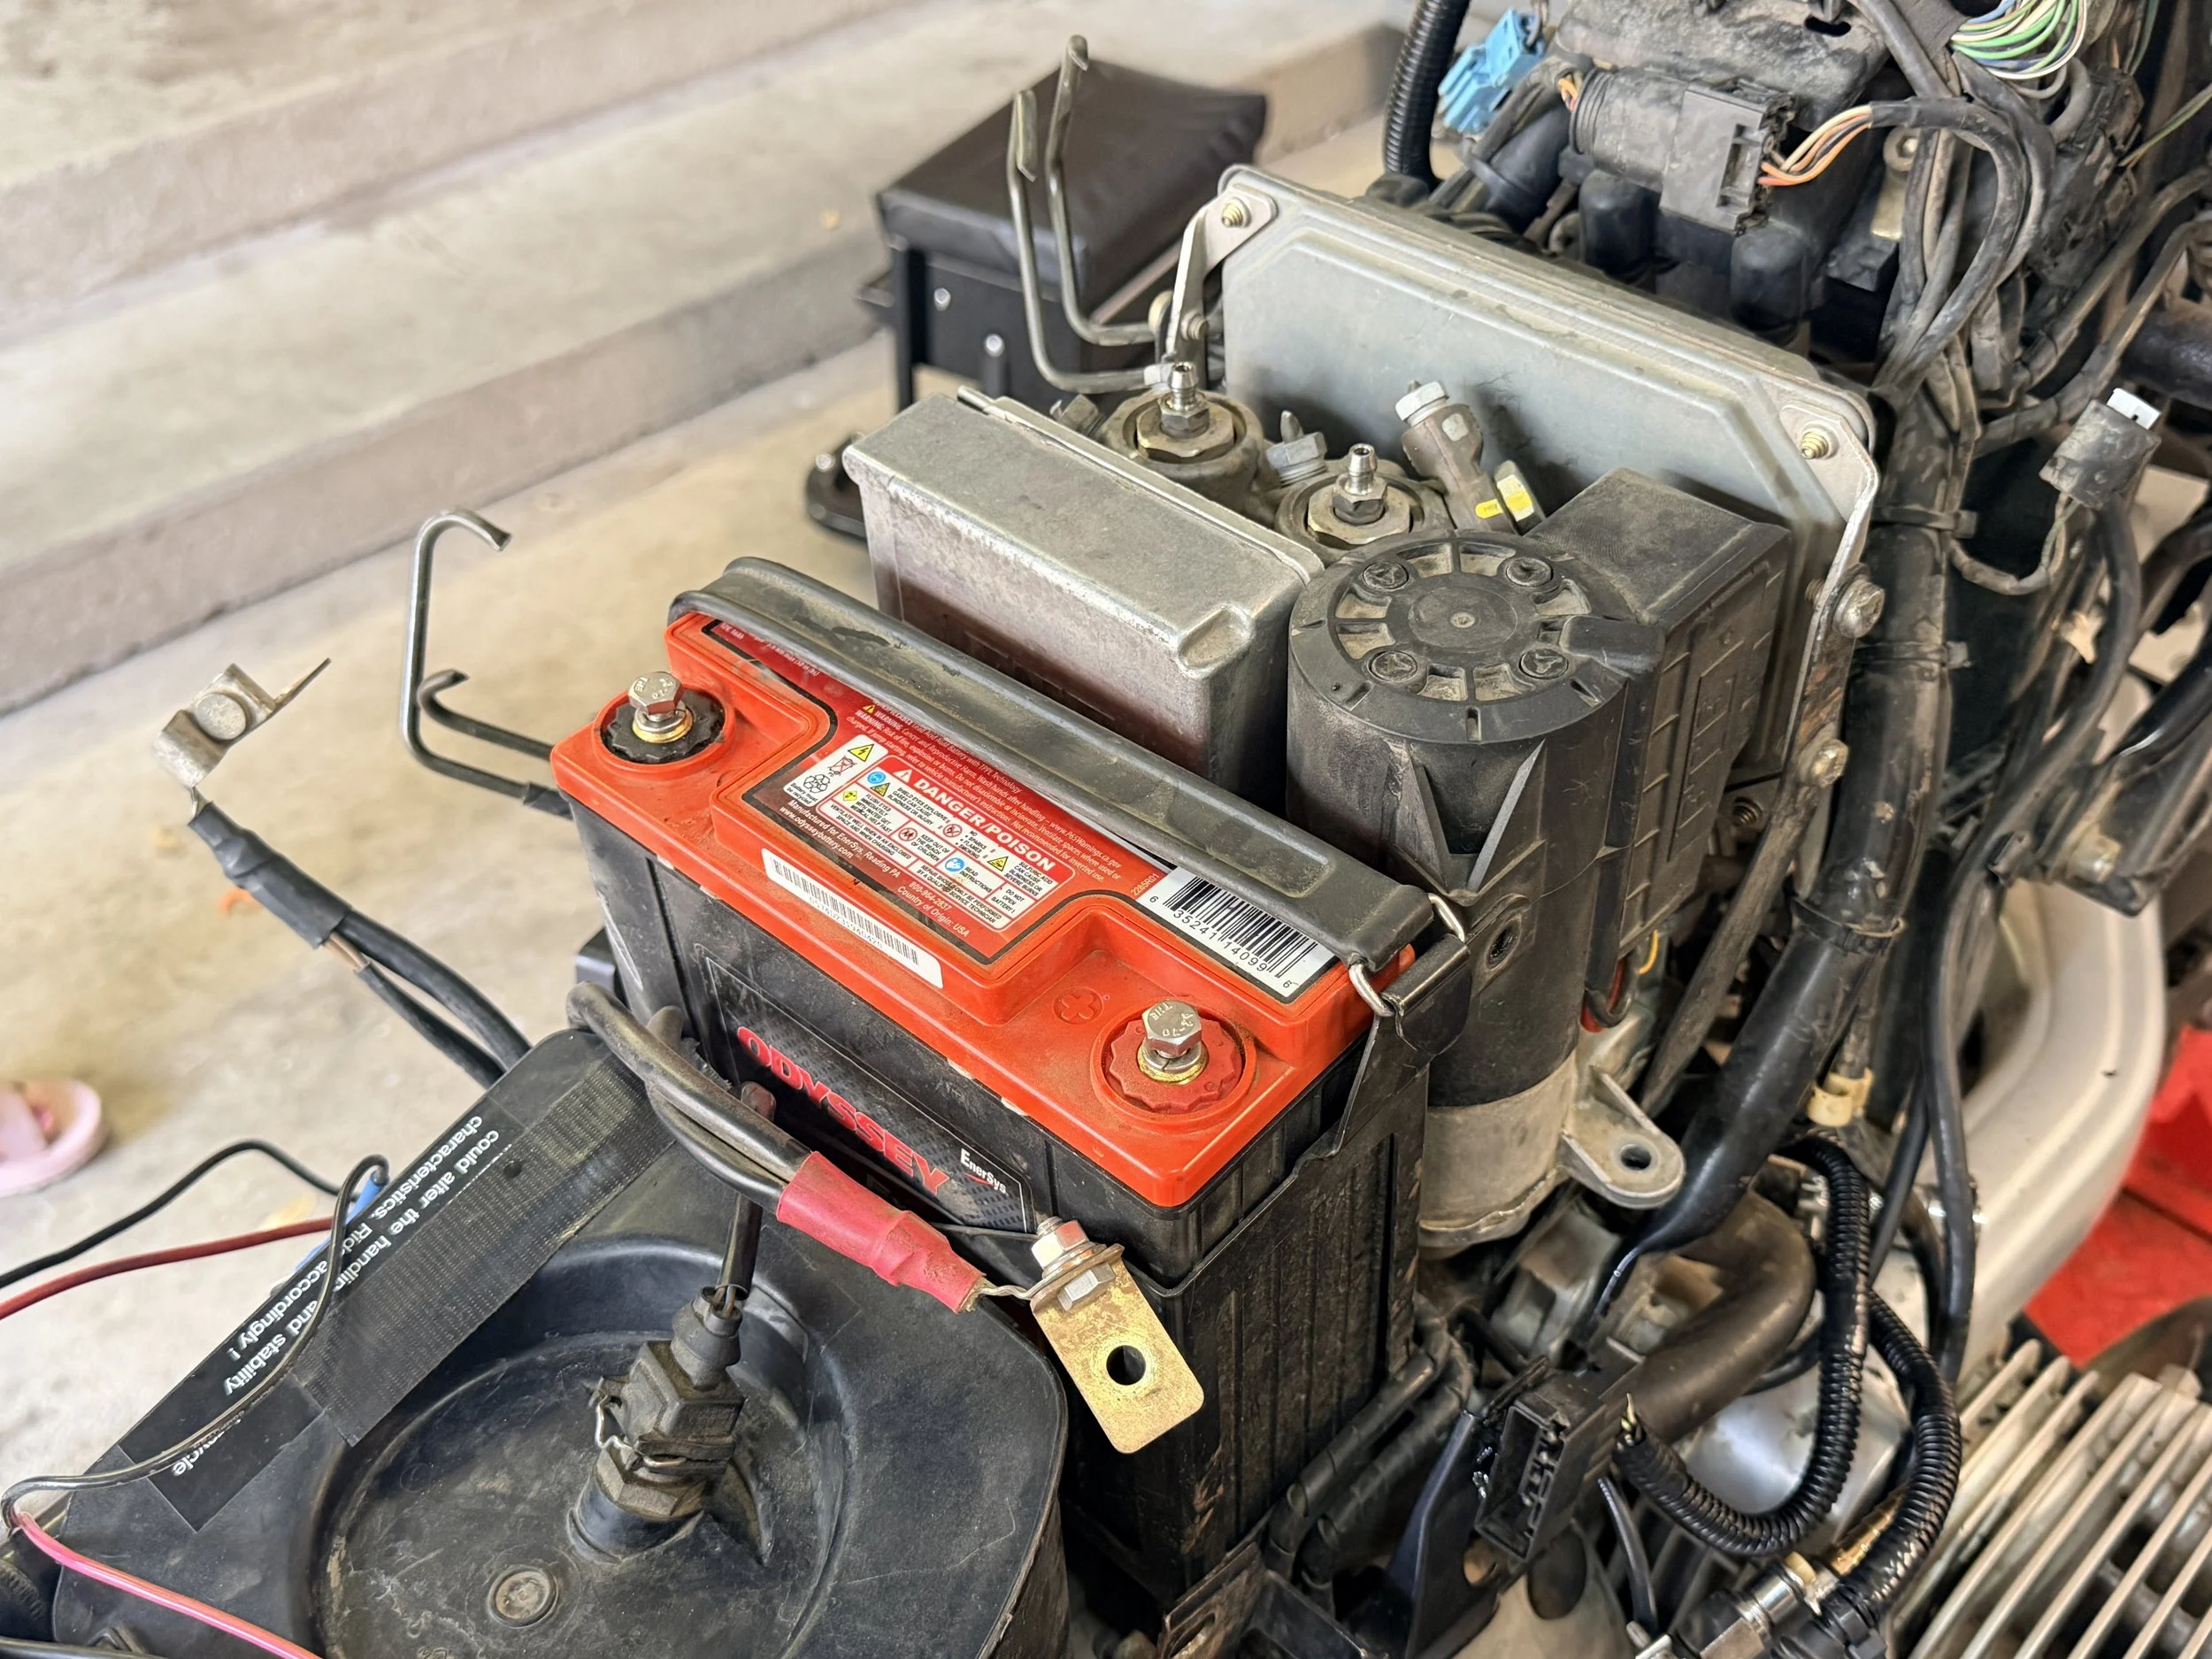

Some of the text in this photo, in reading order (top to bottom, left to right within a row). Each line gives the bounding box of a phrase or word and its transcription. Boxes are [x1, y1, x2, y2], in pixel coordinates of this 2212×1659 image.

[775, 804, 857, 860] www.odysseybattery.com
[785, 798, 833, 830] Manufactured
[826, 825, 841, 836] for
[860, 849, 894, 873] Reading
[887, 866, 903, 879] PA
[911, 777, 1057, 872] DANGER/POISON
[893, 884, 972, 938] Country of Origin: USA
[1174, 910, 1218, 941] 35241
[1223, 941, 1268, 972] 14099
[1283, 979, 1293, 988] 6
[736, 1026, 951, 1197] ODYSSEY
[361, 1112, 491, 1226] characteristics.
[449, 1125, 504, 1176] could
[960, 1148, 1009, 1194] EnerSys
[385, 1204, 422, 1239] the
[412, 1169, 459, 1212] alter
[324, 1233, 395, 1295] handlin
[228, 1257, 336, 1353] accordingly
[281, 1296, 326, 1338] and
[216, 1331, 292, 1399] stability
